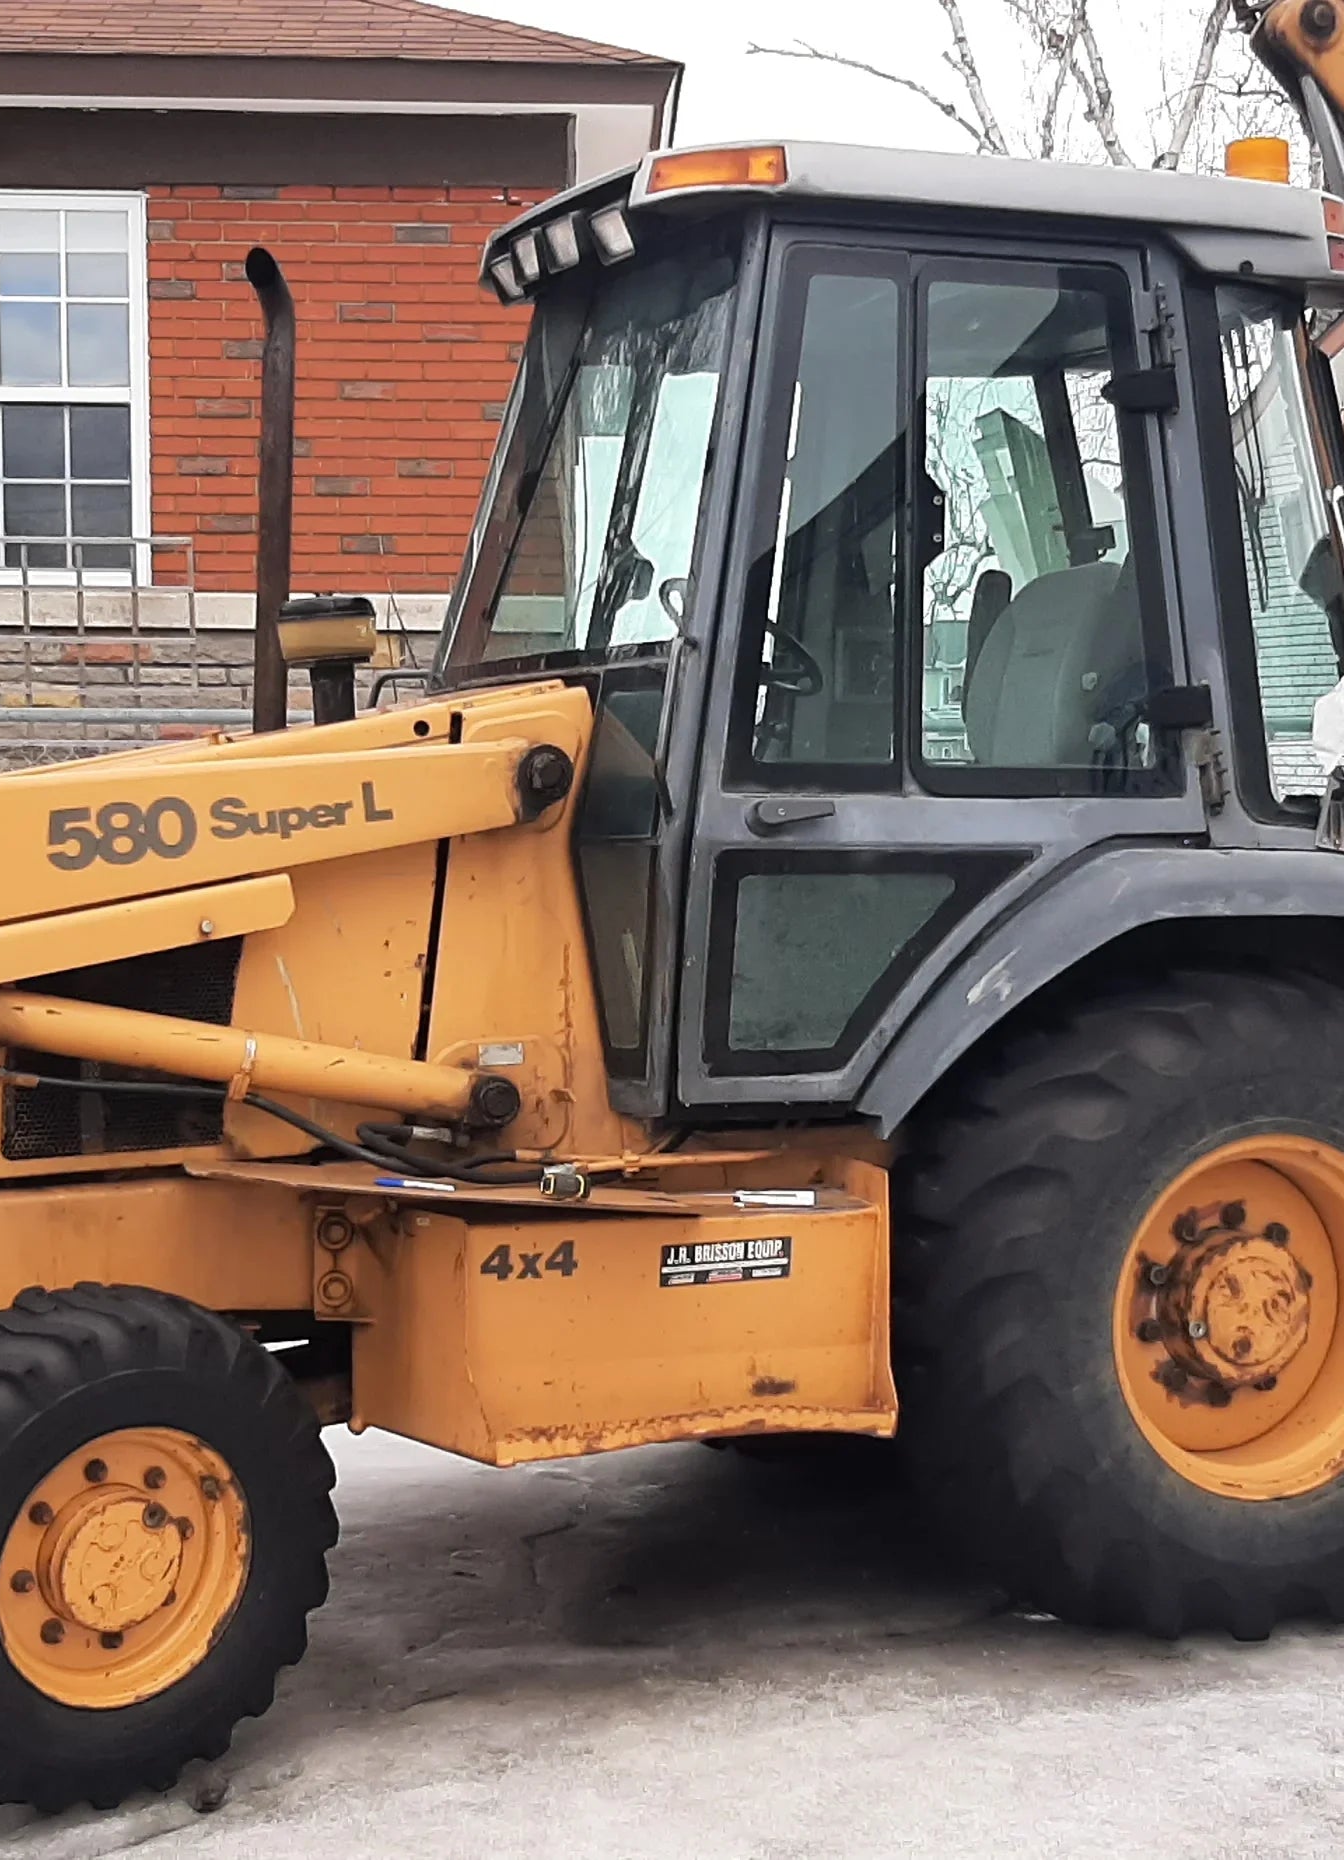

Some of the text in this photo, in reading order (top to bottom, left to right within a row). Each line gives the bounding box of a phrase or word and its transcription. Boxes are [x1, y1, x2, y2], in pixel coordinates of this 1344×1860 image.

[46, 781, 393, 870] 580 Super L
[480, 1240, 578, 1280] 4x4
[694, 1241, 745, 1263] BRISSON
